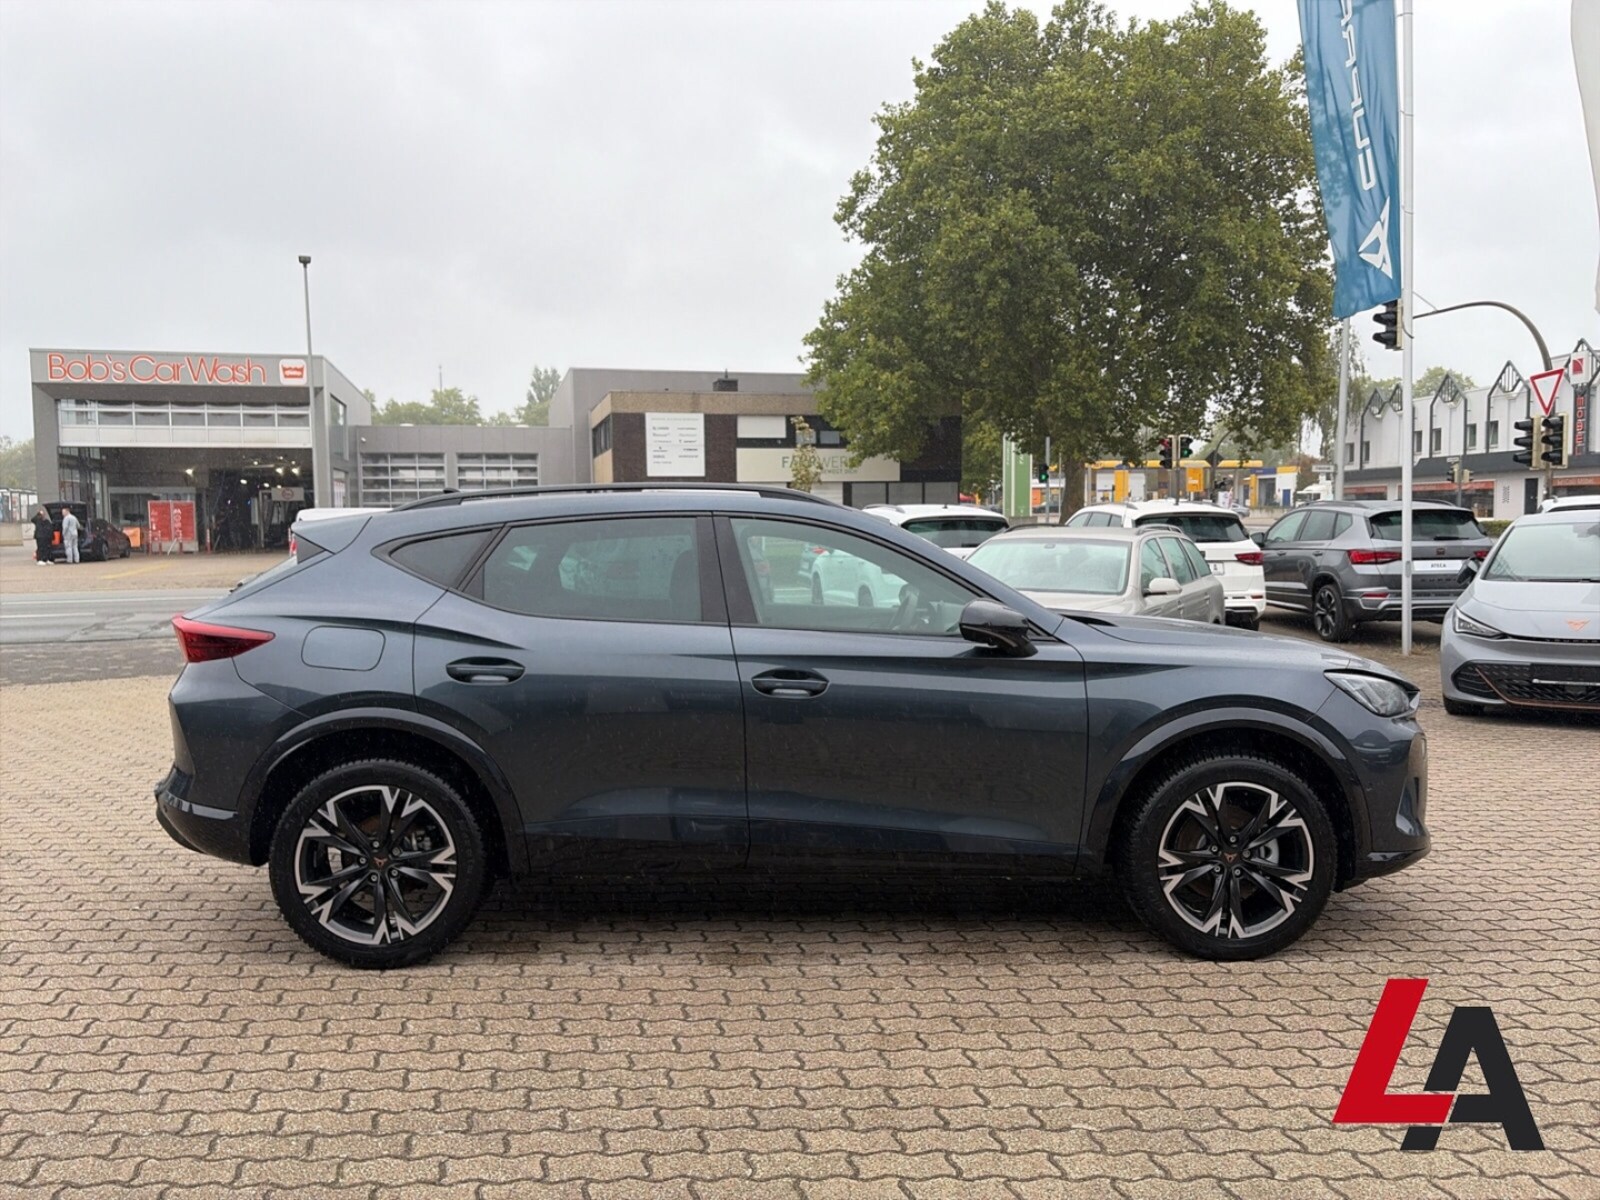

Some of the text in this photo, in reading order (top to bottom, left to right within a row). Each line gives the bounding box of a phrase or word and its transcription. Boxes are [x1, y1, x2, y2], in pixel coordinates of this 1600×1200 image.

[48, 353, 267, 384] Bob's Car Wash
